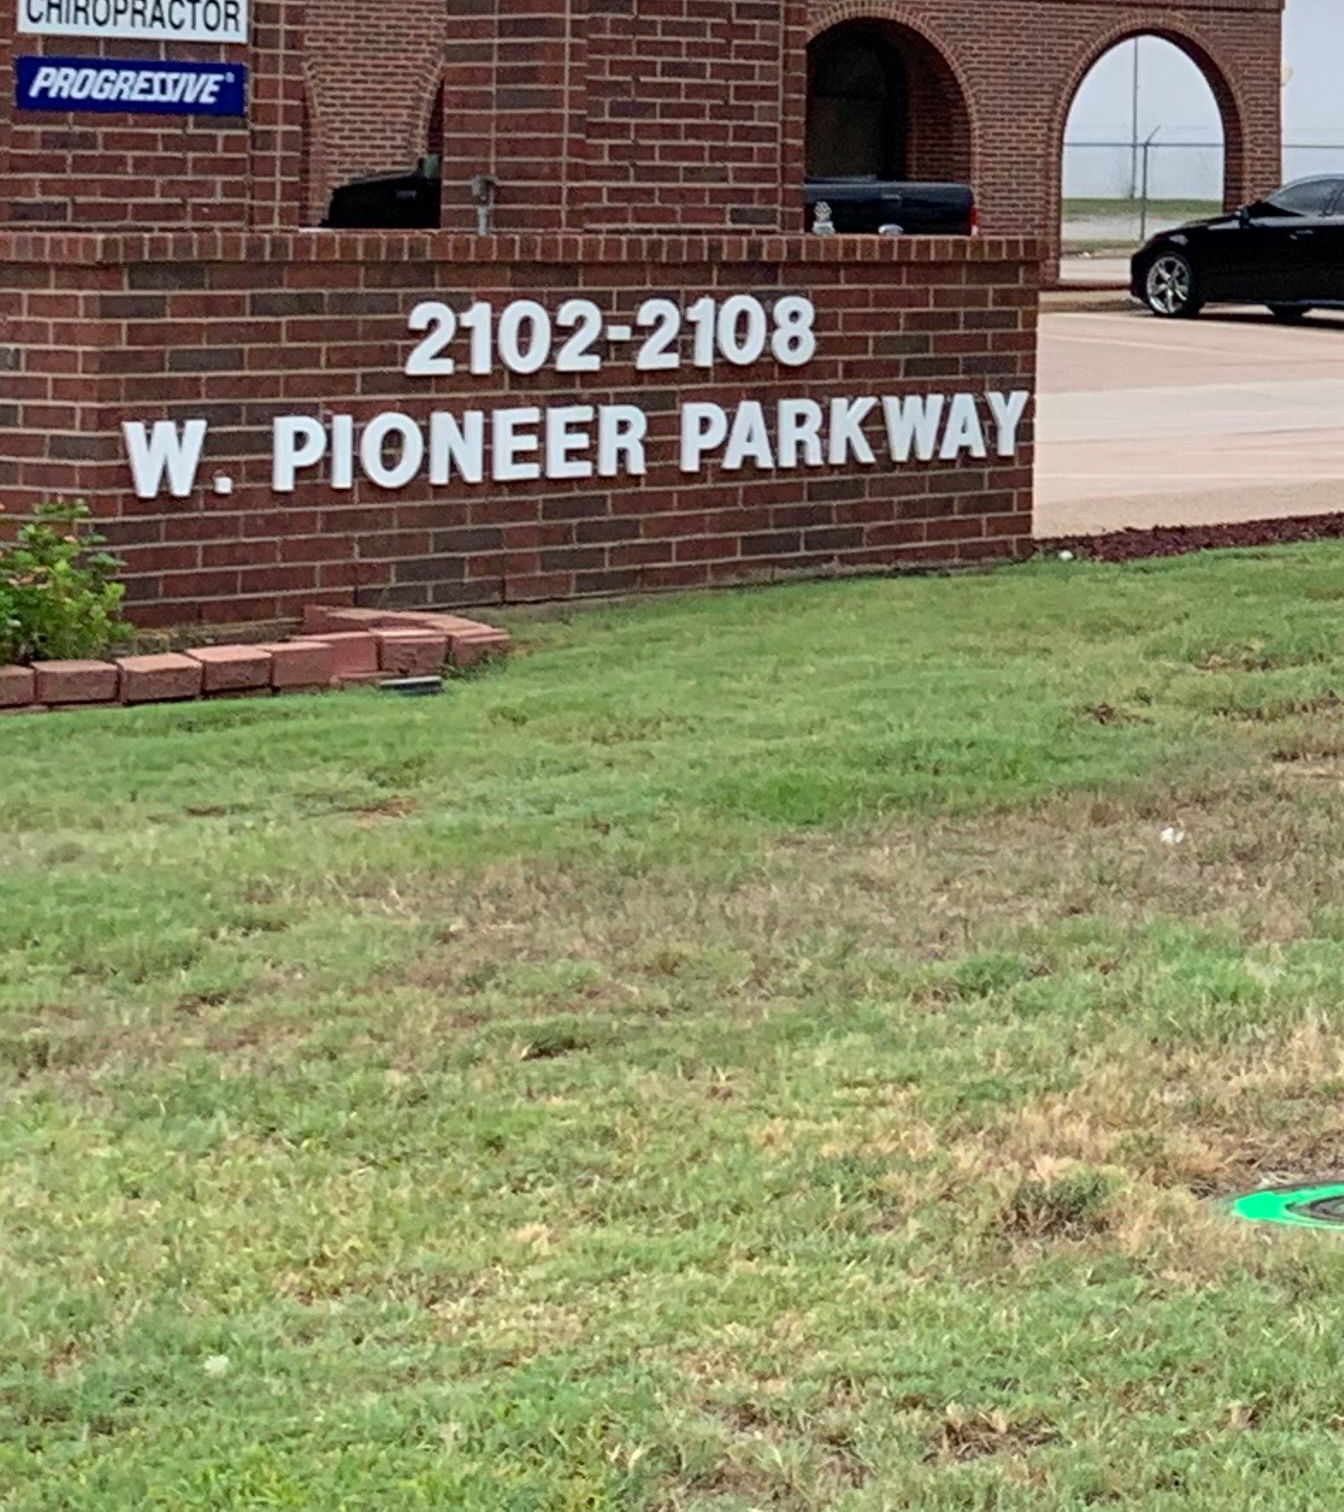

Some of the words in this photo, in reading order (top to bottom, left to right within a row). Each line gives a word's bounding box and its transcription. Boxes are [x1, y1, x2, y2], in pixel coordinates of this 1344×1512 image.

[28, 65, 225, 104] PROGRESSIVE
[404, 295, 818, 376] 2102-2108
[122, 418, 234, 498] W.
[271, 403, 648, 492] PIONEER
[679, 389, 1031, 474] PARKWAY
